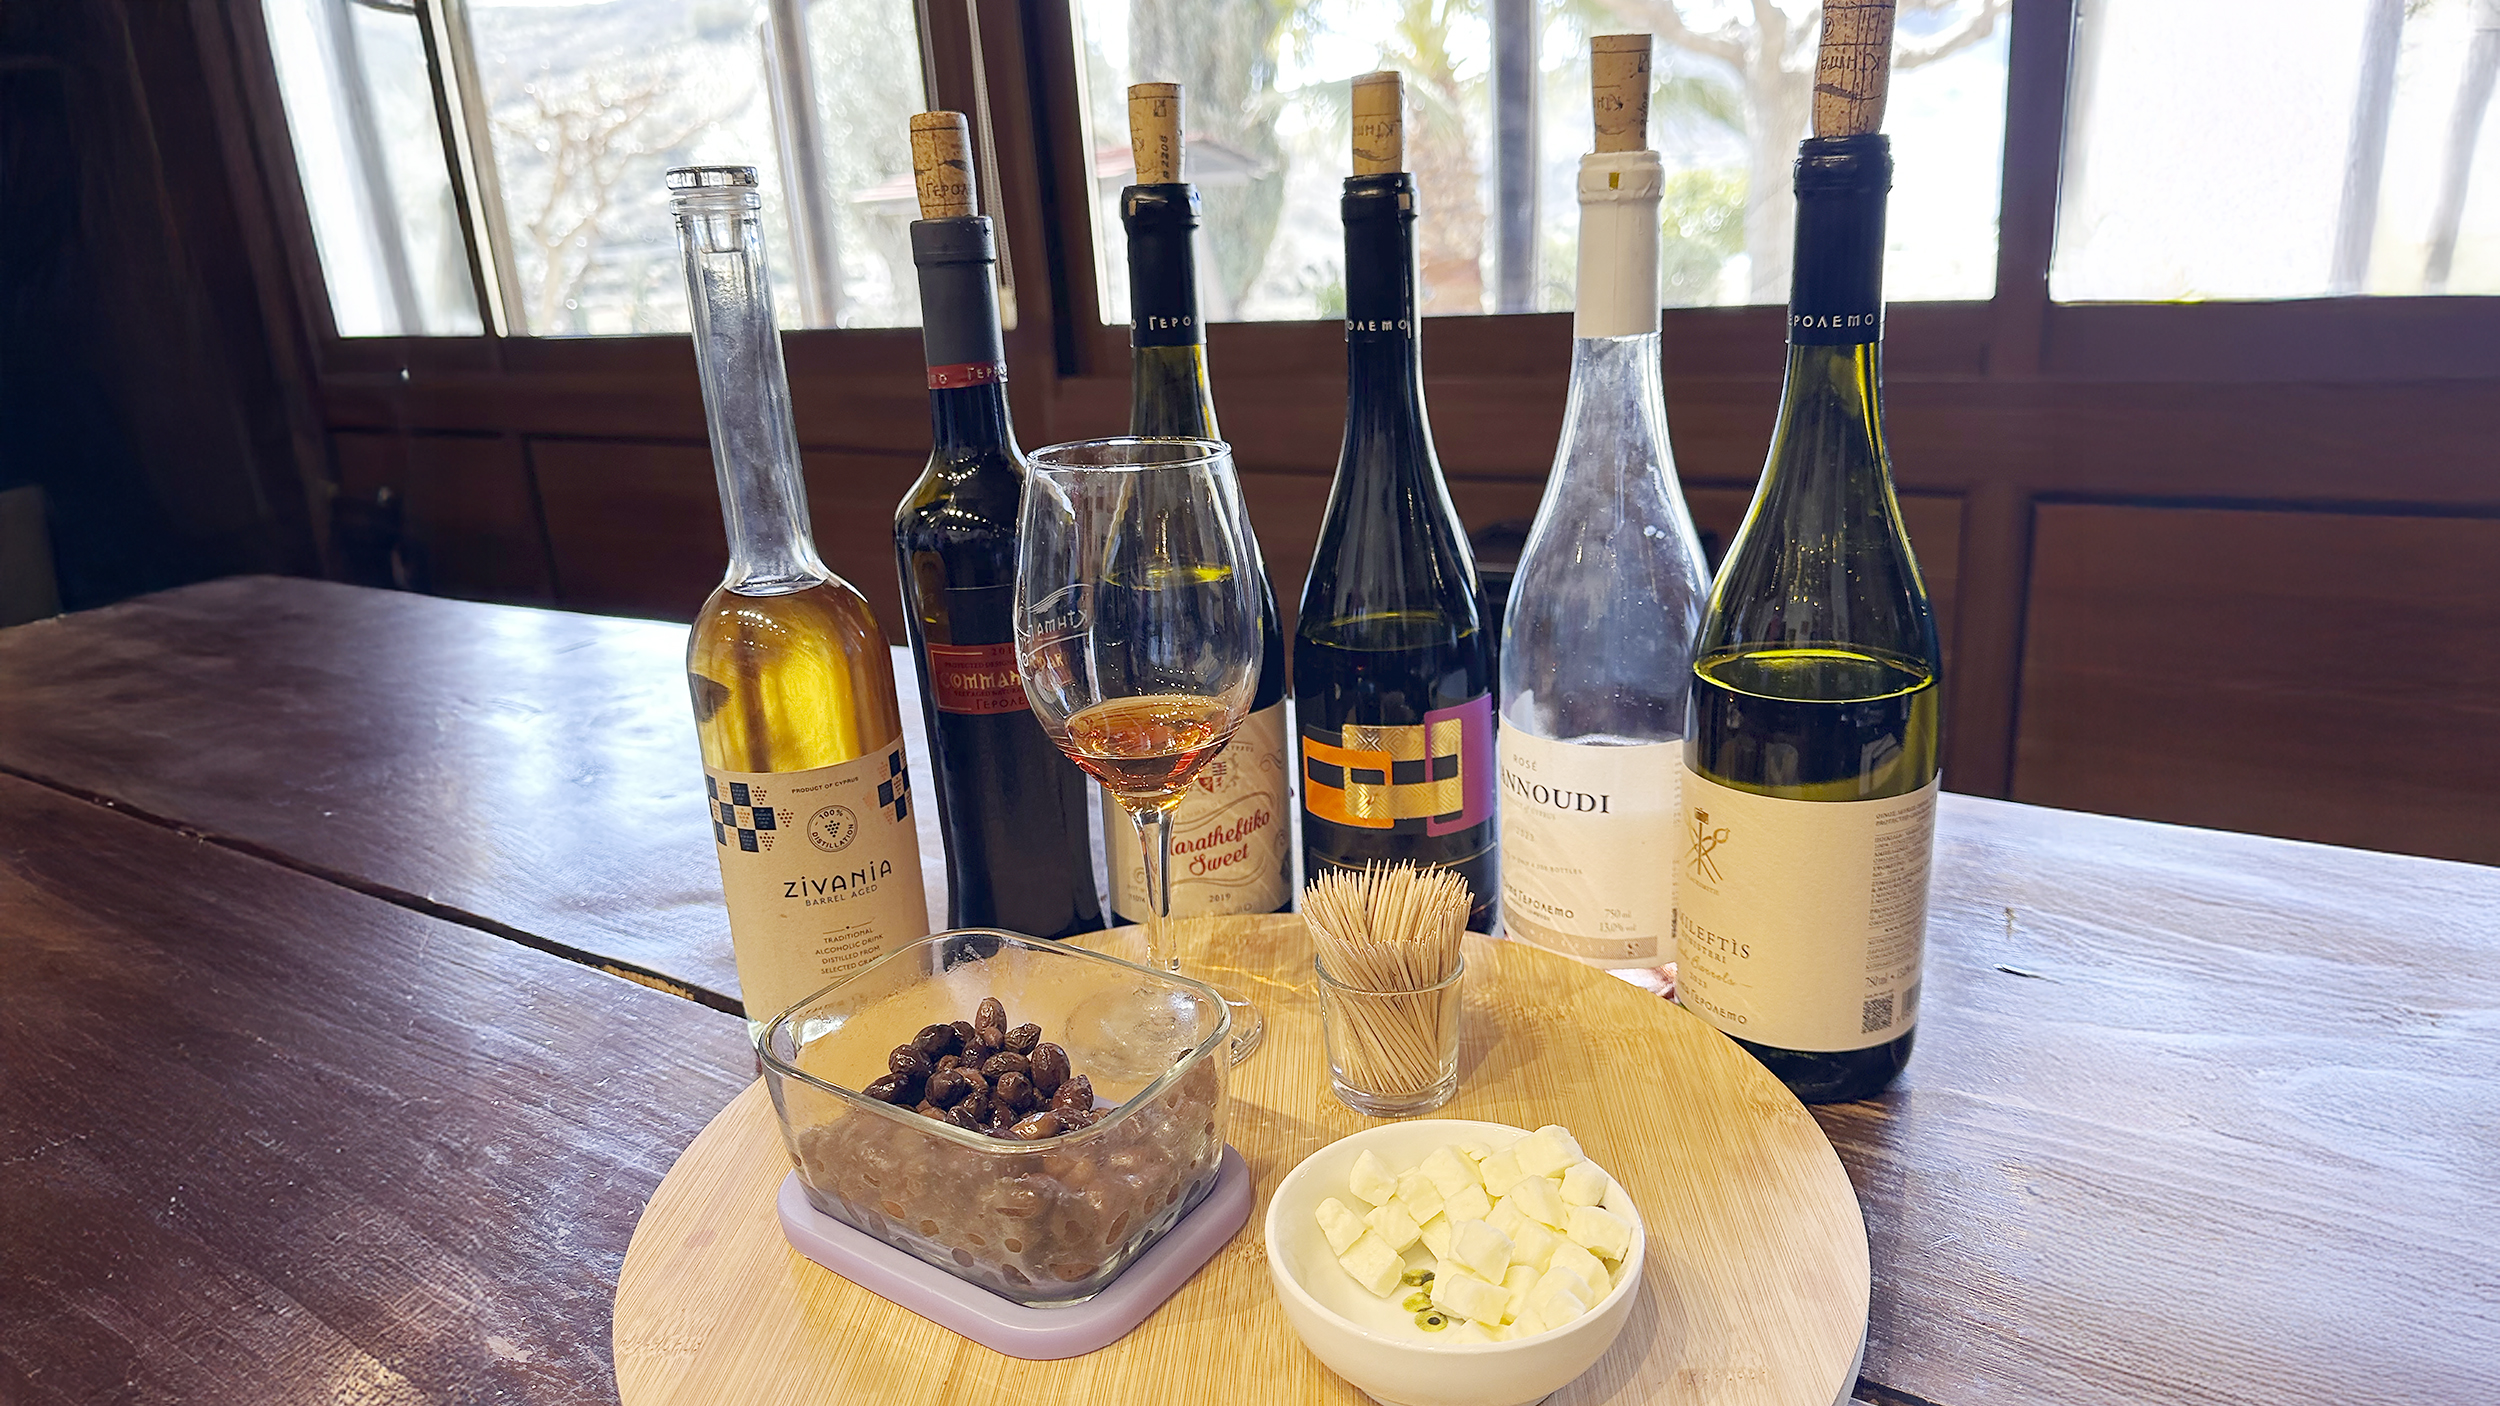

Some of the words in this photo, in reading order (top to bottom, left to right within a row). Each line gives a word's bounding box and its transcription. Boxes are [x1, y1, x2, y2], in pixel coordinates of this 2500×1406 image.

[940, 670, 1022, 691] COMMAN
[975, 696, 1026, 711] ΓΕΡΟΛΕ
[791, 784, 823, 795] PRODUCT
[835, 776, 859, 788] CYPRUS
[819, 808, 844, 820] 100%
[811, 823, 854, 849] DISTILLATION
[1189, 843, 1248, 877] Sweet
[805, 894, 846, 907] BARREL
[851, 884, 878, 899] AGED
[1209, 893, 1231, 903] 2019
[815, 940, 861, 956] ALCOHOLIC
[861, 934, 884, 946] DRINK
[824, 927, 874, 944] TRADITIONAL
[822, 951, 859, 965] DISTILLED
[860, 945, 881, 957] FROM
[821, 962, 857, 975] SELECTED
